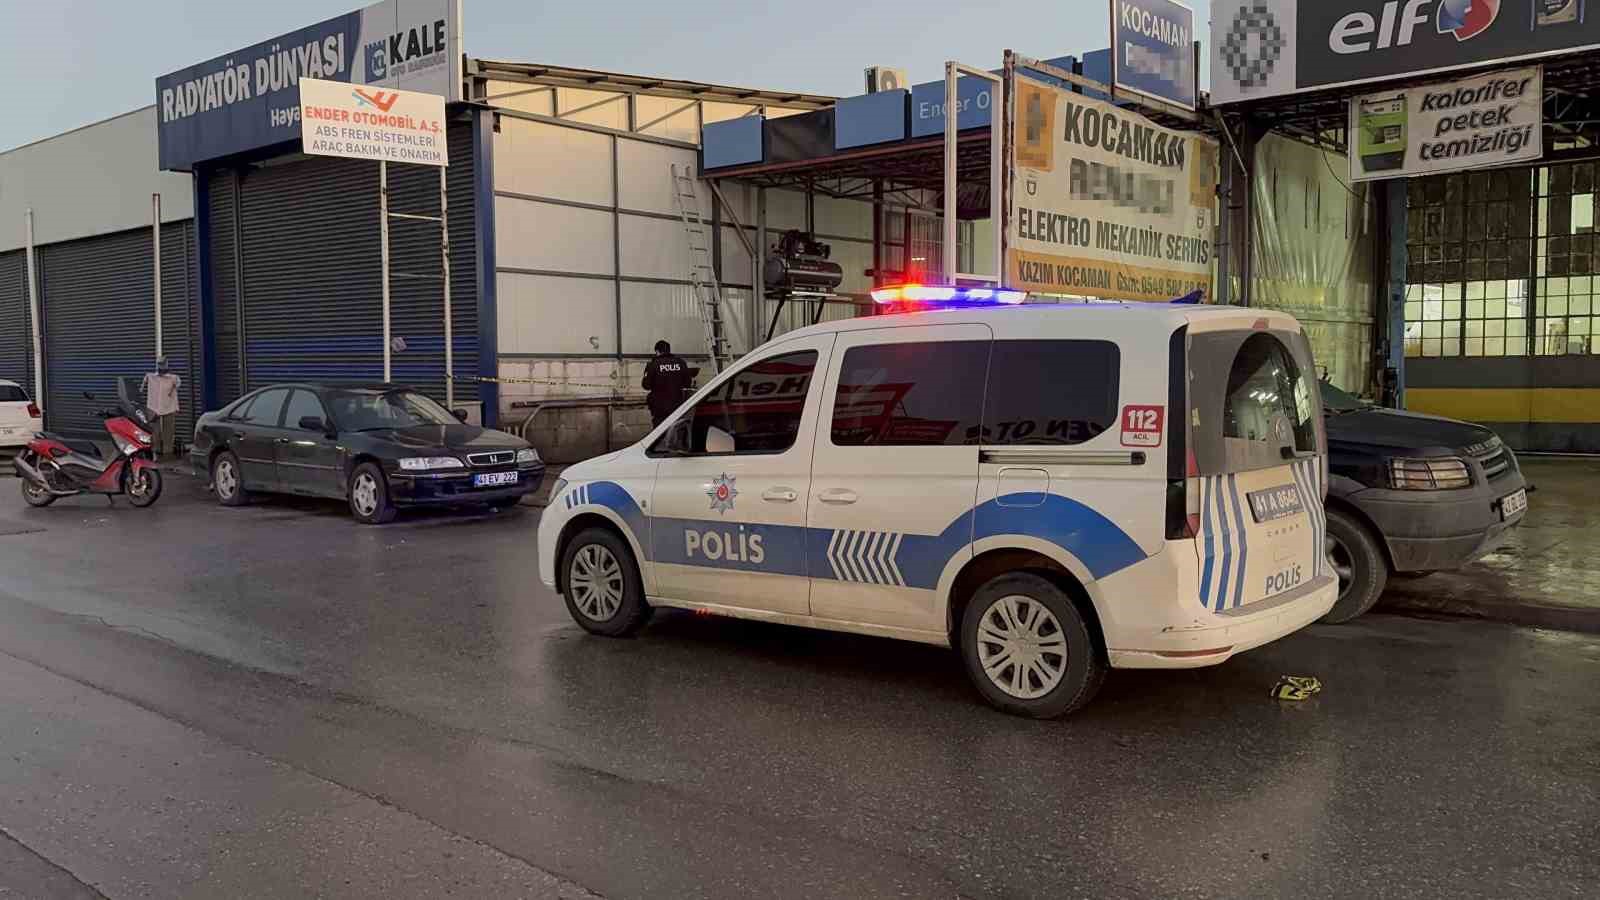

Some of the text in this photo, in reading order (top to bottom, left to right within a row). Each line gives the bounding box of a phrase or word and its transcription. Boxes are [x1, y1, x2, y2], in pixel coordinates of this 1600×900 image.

[390, 20, 445, 65] KALE
[1121, 1, 1188, 48] KOCAMAN
[1328, 0, 1429, 54] elf
[162, 60, 250, 123] RADYATÖR
[256, 33, 344, 96] DÜNYASI
[1420, 77, 1532, 113] kalorifer
[305, 106, 349, 123] ENDER
[353, 111, 416, 130] OTOMOBİL
[920, 98, 970, 120] Ener
[1434, 104, 1516, 138] petek
[315, 126, 435, 147] ABS FREN SİSTEMLERİ
[346, 142, 381, 156] BAKIM
[384, 146, 398, 157] VE
[401, 147, 441, 161] ONARIM
[1064, 102, 1186, 168] KOCAMAN
[1418, 126, 1533, 162] temizliği
[1018, 207, 1209, 265] ELEKTRO MEKANİK SERVİS
[1018, 260, 1054, 286] KAZIM
[1057, 264, 1111, 291] KOCAMAN
[1127, 409, 1158, 430] 112
[684, 524, 765, 564] POLİS
[1265, 562, 1301, 595] POLİS
